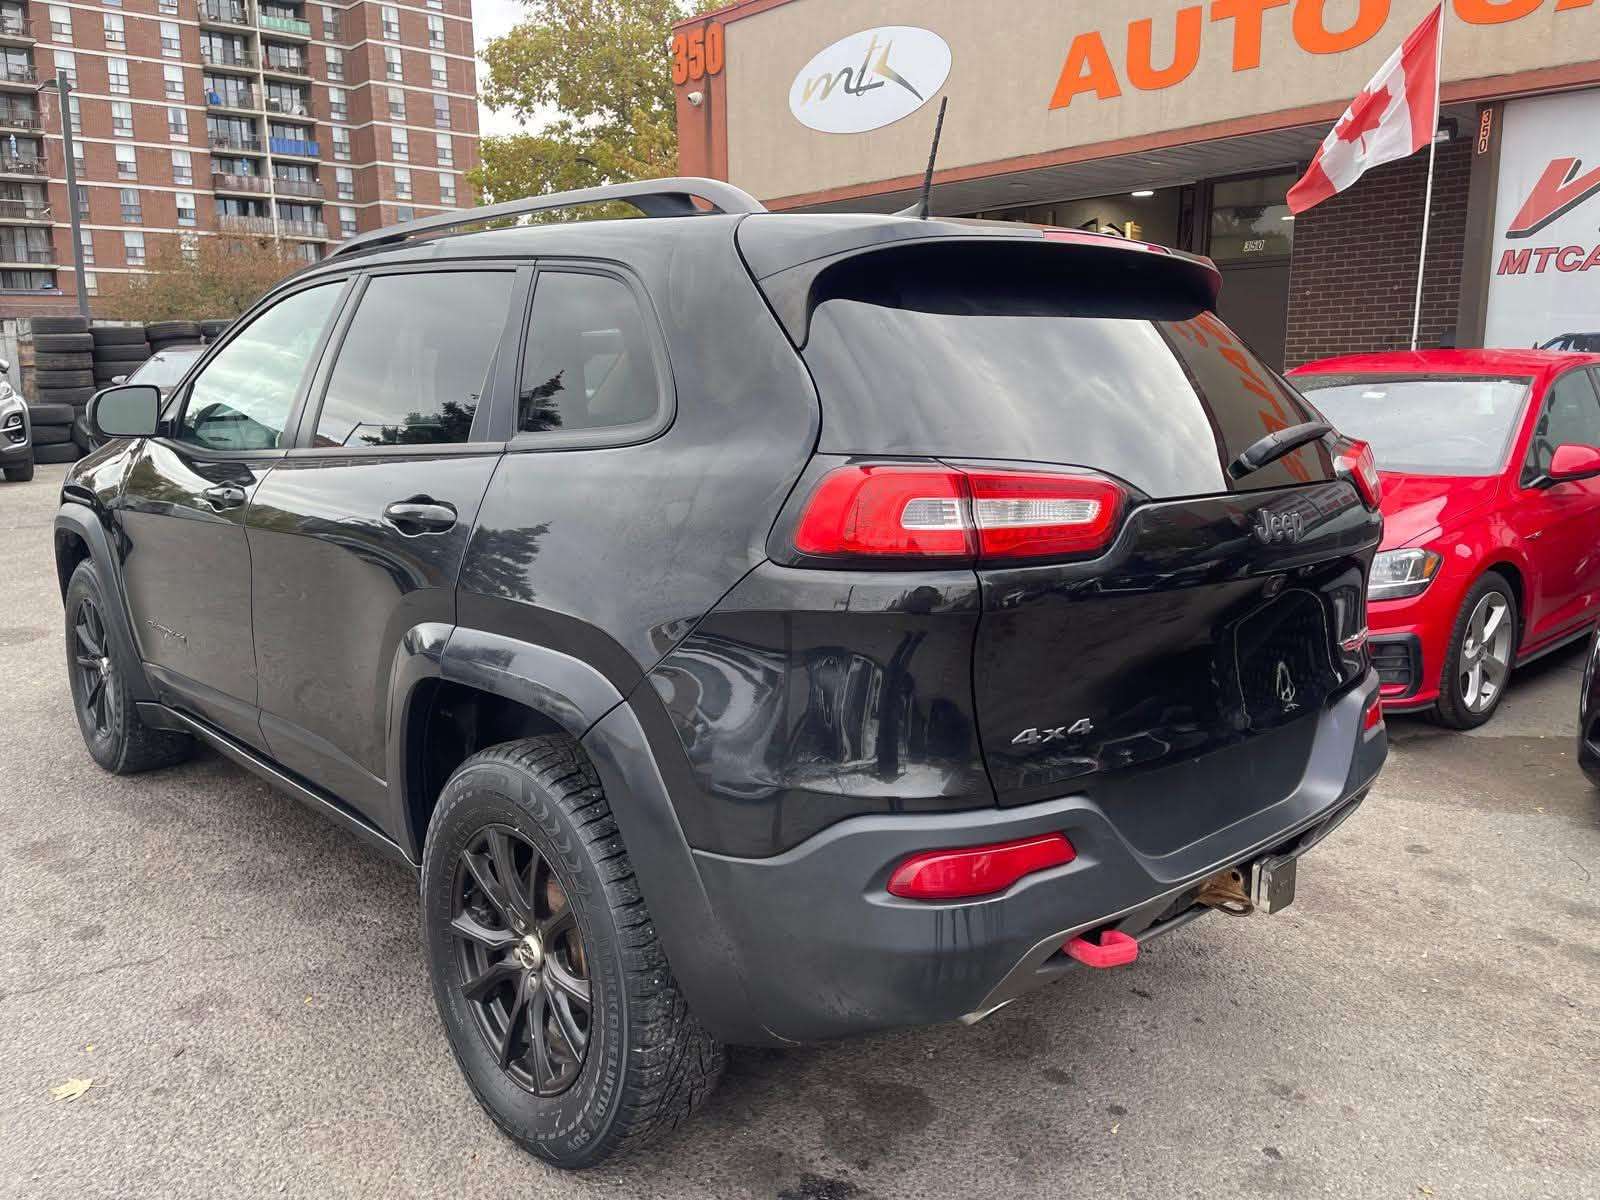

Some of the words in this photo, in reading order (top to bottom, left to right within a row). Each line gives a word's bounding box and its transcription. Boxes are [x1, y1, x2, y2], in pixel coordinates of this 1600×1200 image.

[671, 22, 723, 85] 350
[1048, 0, 1391, 110] AUTO
[1478, 110, 1491, 154] 350
[1256, 508, 1304, 542] Jeep
[1011, 718, 1093, 744] 4x4
